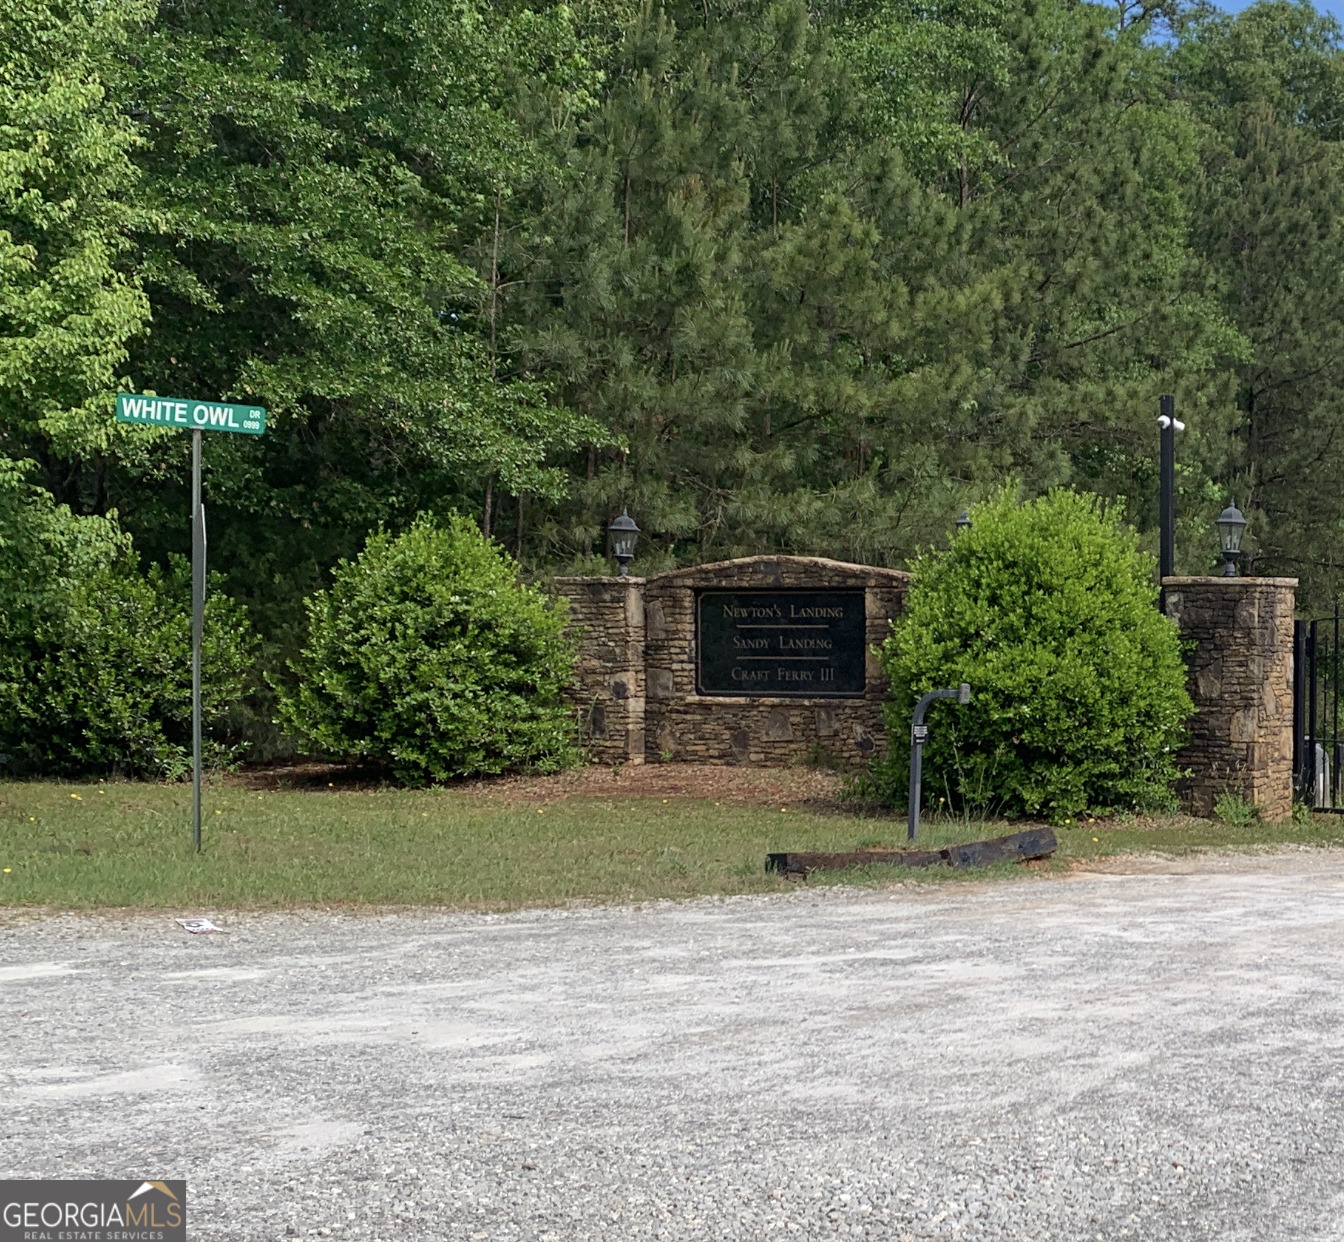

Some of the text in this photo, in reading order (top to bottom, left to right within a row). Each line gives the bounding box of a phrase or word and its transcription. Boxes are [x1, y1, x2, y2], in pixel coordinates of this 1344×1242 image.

[122, 397, 261, 428] WHITE OWL DR
[723, 604, 844, 618] NEWTON'S LANDING
[733, 635, 833, 649] SANDY LANDING
[731, 667, 835, 681] CRAFT FERRY III
